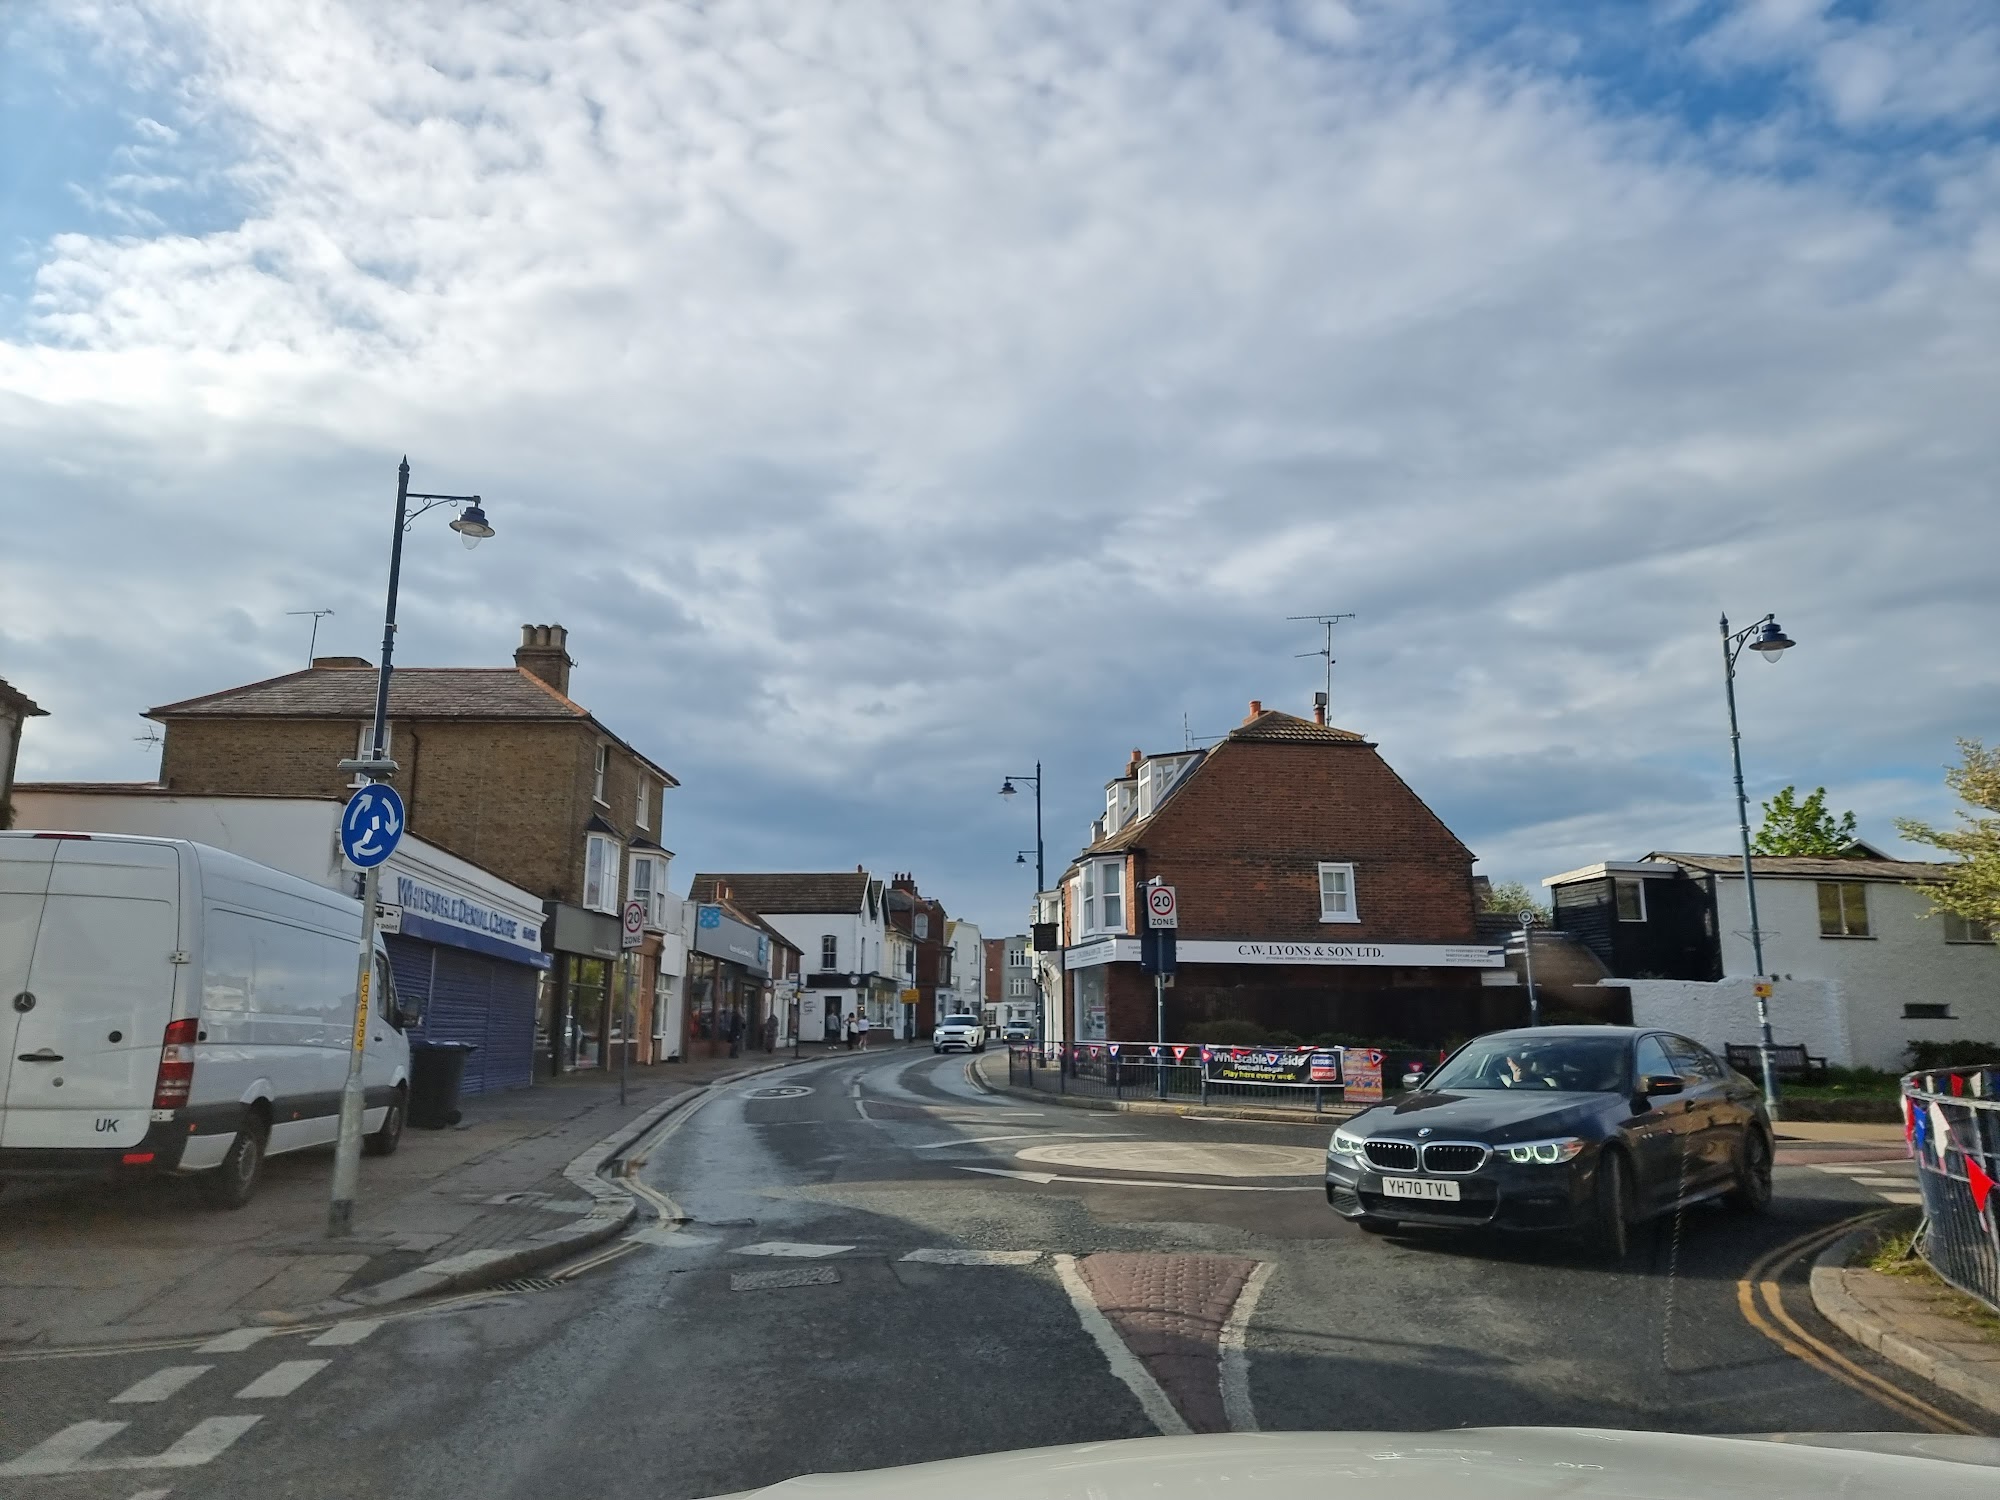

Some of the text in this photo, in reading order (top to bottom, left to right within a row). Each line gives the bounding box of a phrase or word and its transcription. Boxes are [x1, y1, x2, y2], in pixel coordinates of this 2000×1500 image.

[1153, 896, 1171, 907] 20
[628, 911, 640, 924] 20
[1151, 918, 1175, 926] ZONE
[380, 923, 398, 931] point
[624, 936, 641, 945] ZONE
[1238, 945, 1385, 958] C.W. LYONS & SON LTD.
[1222, 1069, 1239, 1079] Play
[1256, 1072, 1277, 1081] every
[1277, 1073, 1297, 1081] week
[95, 1118, 120, 1132] UK
[1388, 1180, 1453, 1197] YH70 TVL
